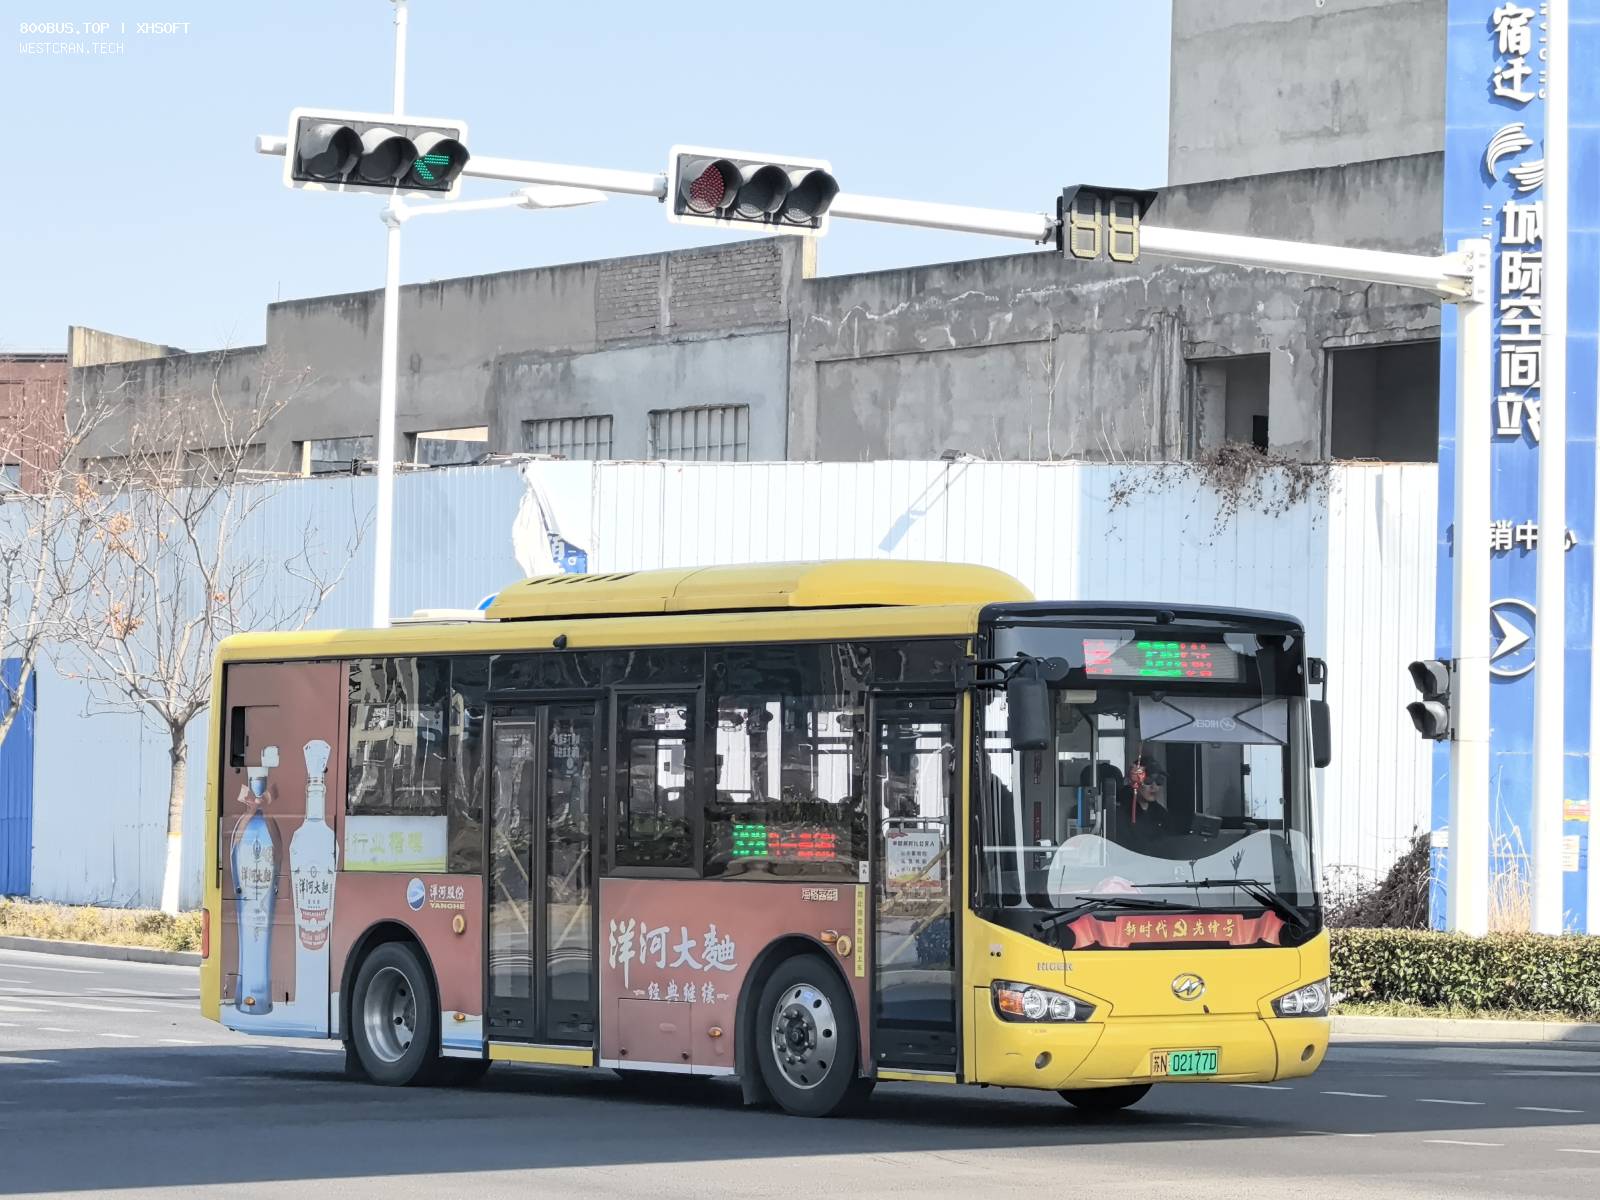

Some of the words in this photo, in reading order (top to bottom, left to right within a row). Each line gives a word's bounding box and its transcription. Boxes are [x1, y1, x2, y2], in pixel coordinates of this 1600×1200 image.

[1493, 2, 1536, 103] 宿迁
[1124, 920, 1168, 938] 新时代
